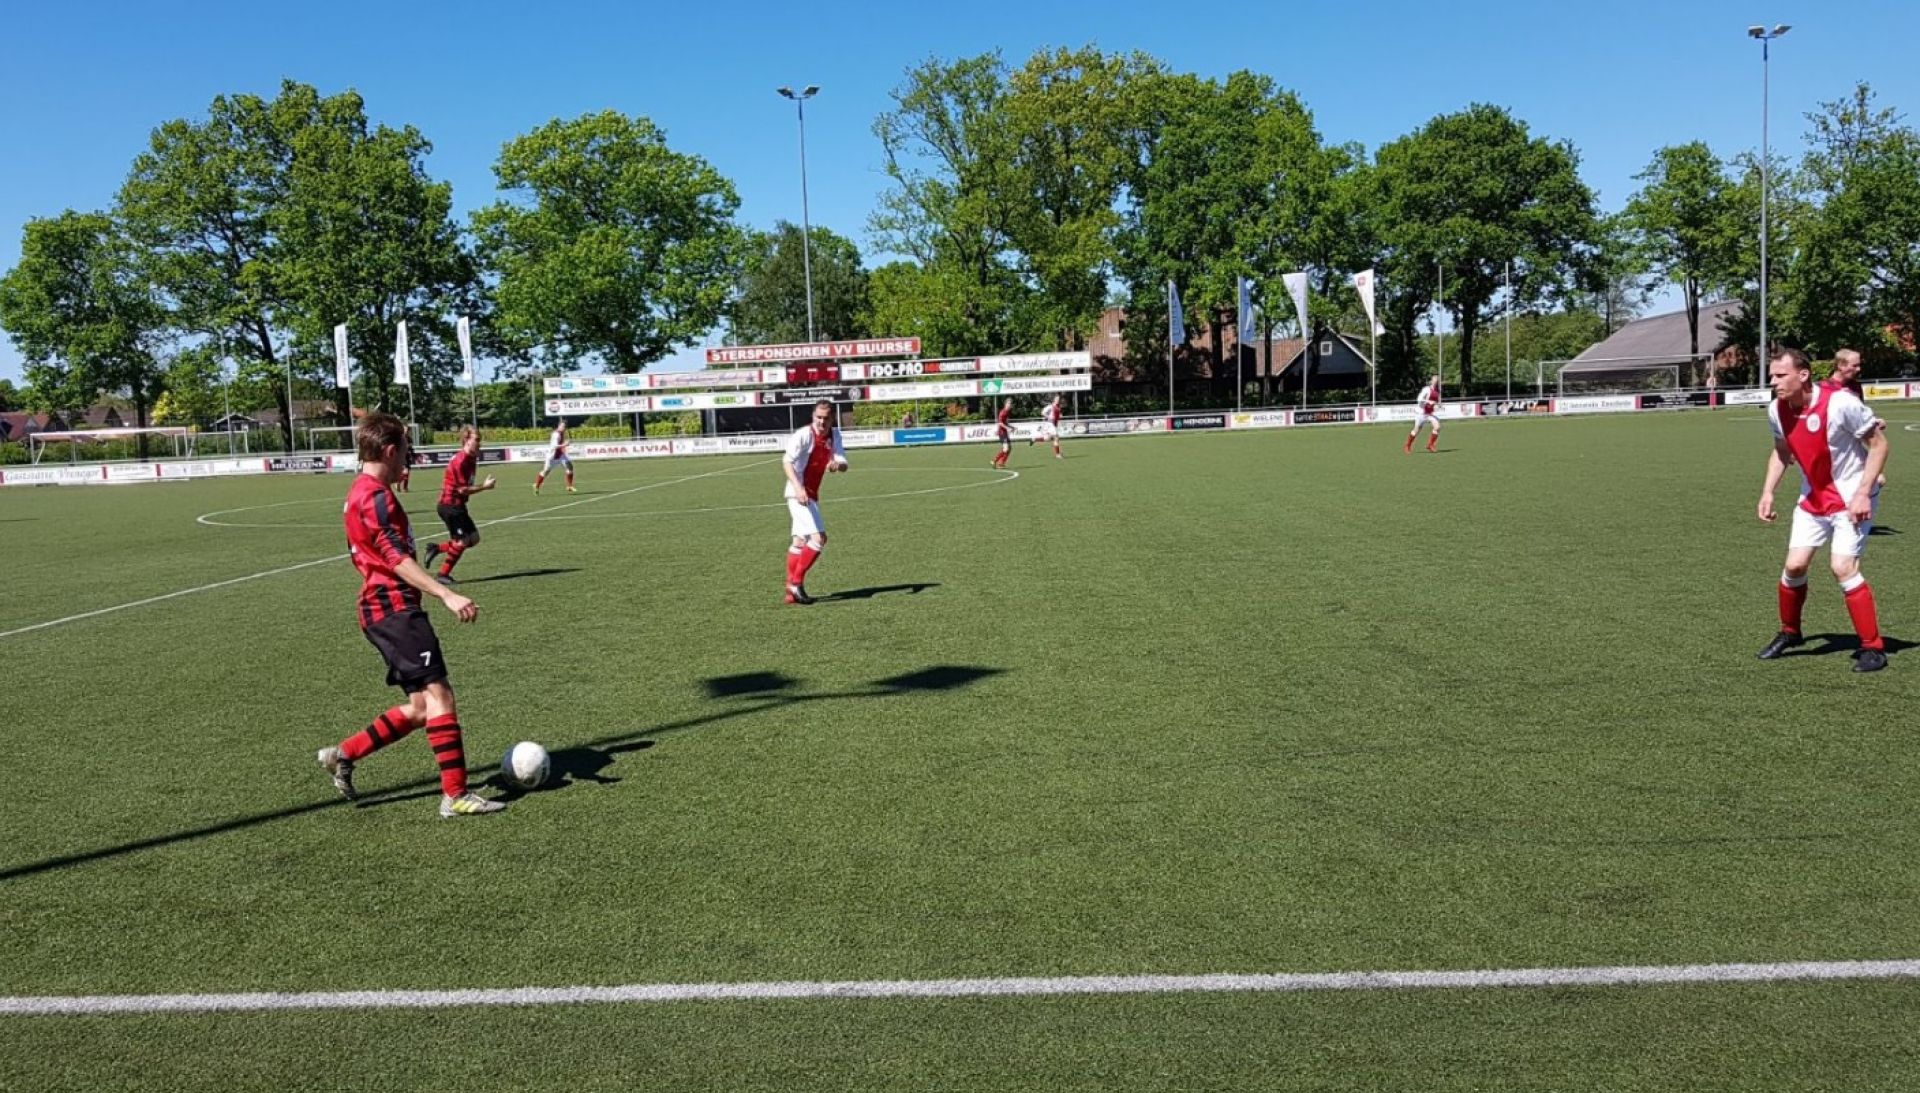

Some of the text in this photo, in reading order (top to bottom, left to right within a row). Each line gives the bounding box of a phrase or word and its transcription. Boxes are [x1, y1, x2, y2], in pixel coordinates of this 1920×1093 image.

[711, 341, 912, 361] STERSPONSOREN VV BUURSE
[584, 400, 611, 408] AVEST
[615, 399, 647, 407] SPORT
[967, 428, 992, 439] JBC
[586, 444, 671, 455] MAMA LIVIA
[420, 650, 431, 667] 7
